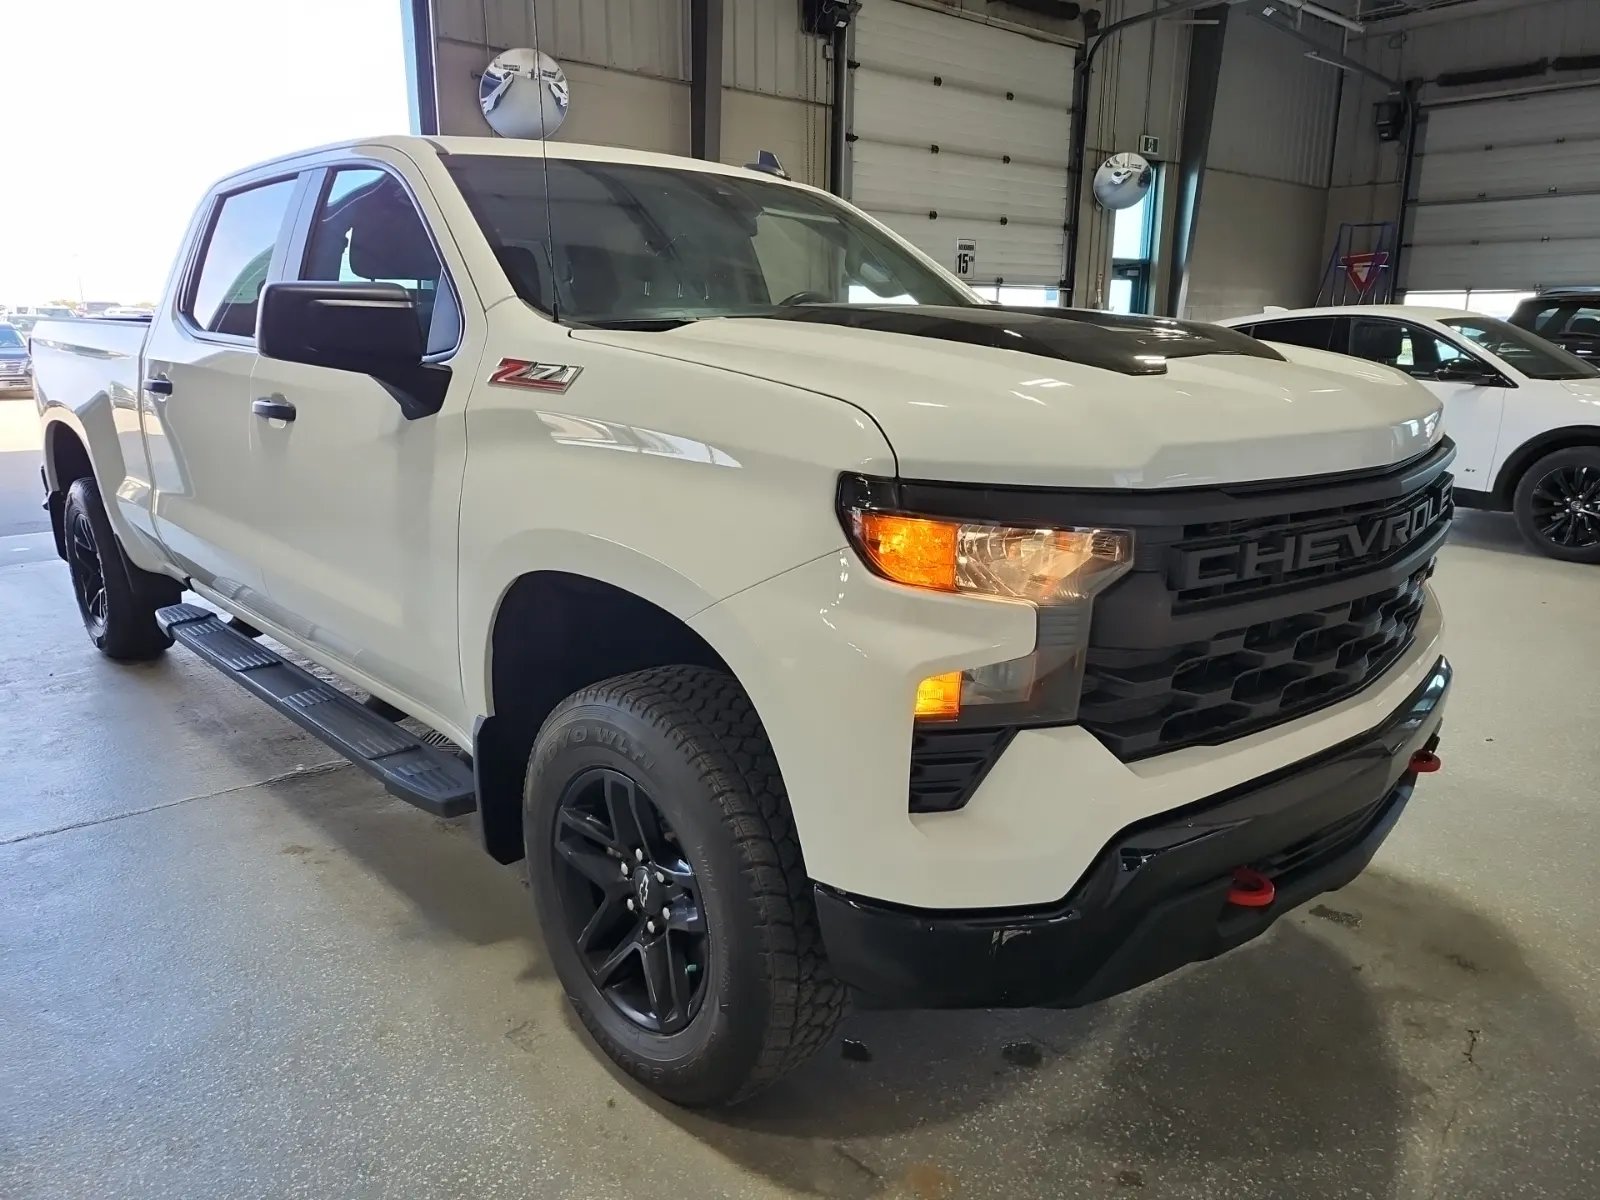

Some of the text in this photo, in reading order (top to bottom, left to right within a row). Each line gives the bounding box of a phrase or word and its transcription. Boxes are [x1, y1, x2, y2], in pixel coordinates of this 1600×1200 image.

[957, 253, 969, 274] 15
[487, 357, 585, 395] Z71
[1183, 483, 1456, 590] CHEVROLE
